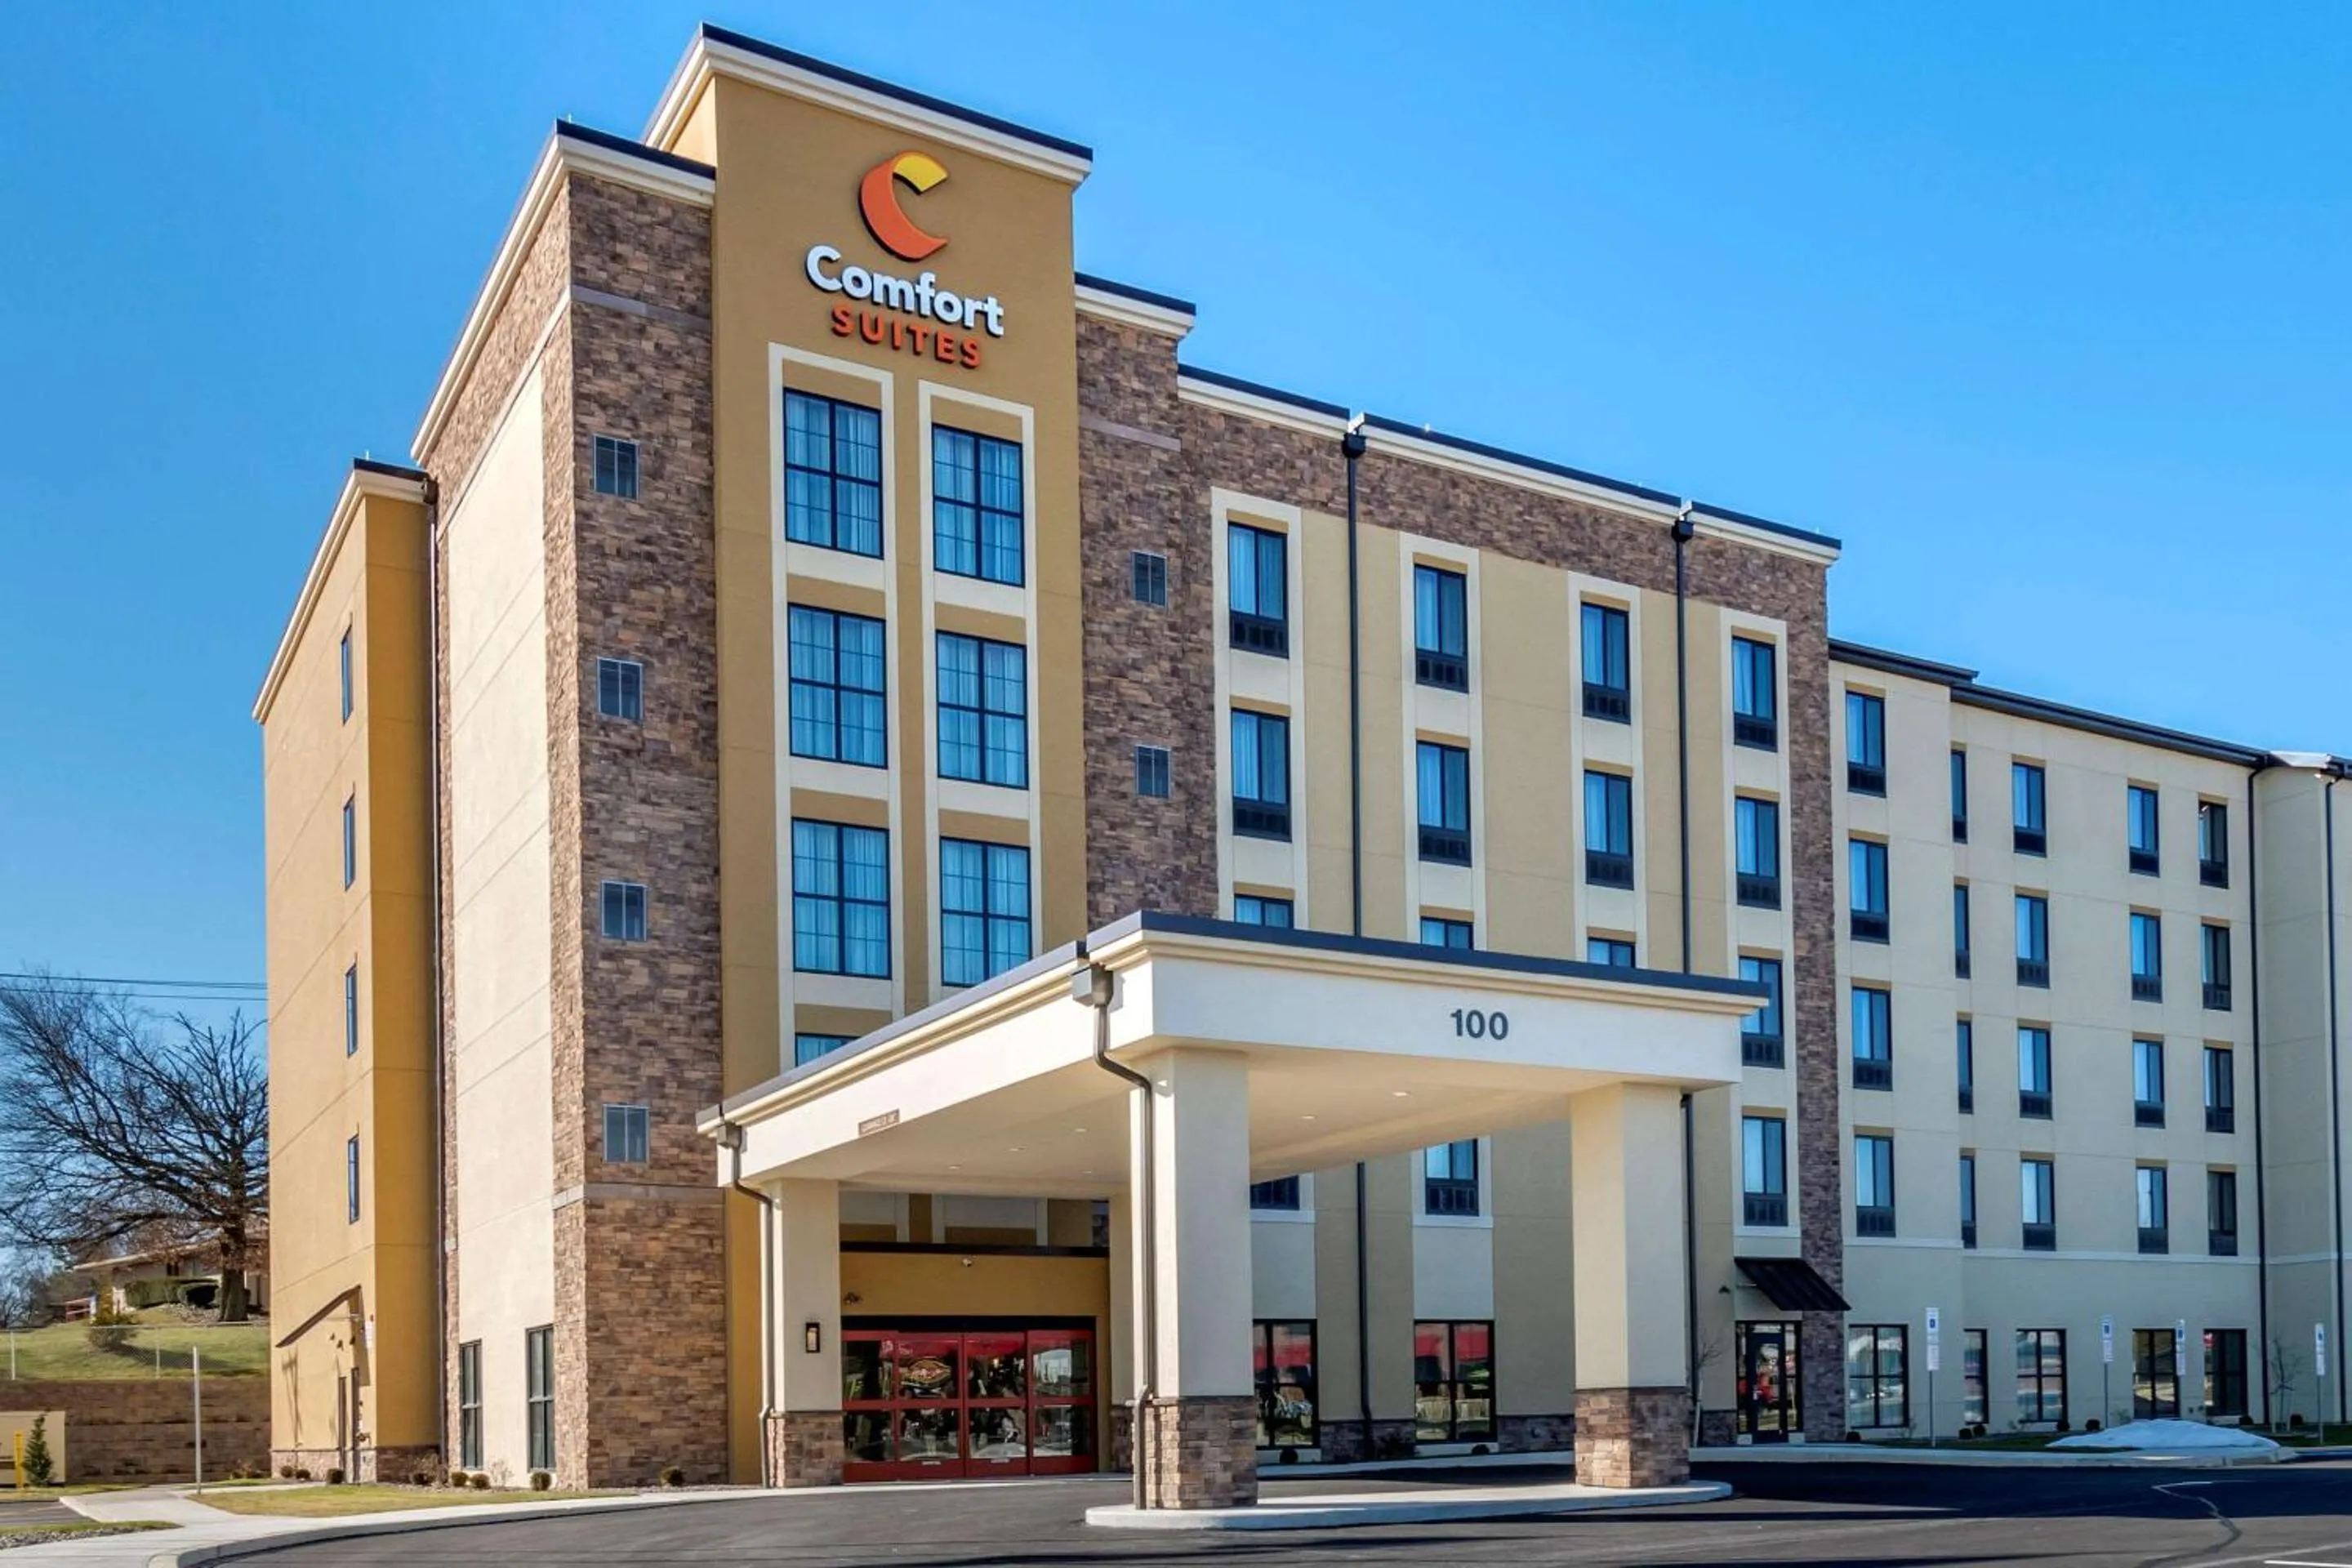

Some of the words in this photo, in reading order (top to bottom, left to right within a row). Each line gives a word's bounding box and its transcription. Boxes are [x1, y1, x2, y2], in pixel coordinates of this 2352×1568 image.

[805, 245, 1004, 337] Comfort
[831, 304, 983, 369] SUITES
[1450, 1009, 1508, 1040] 100
